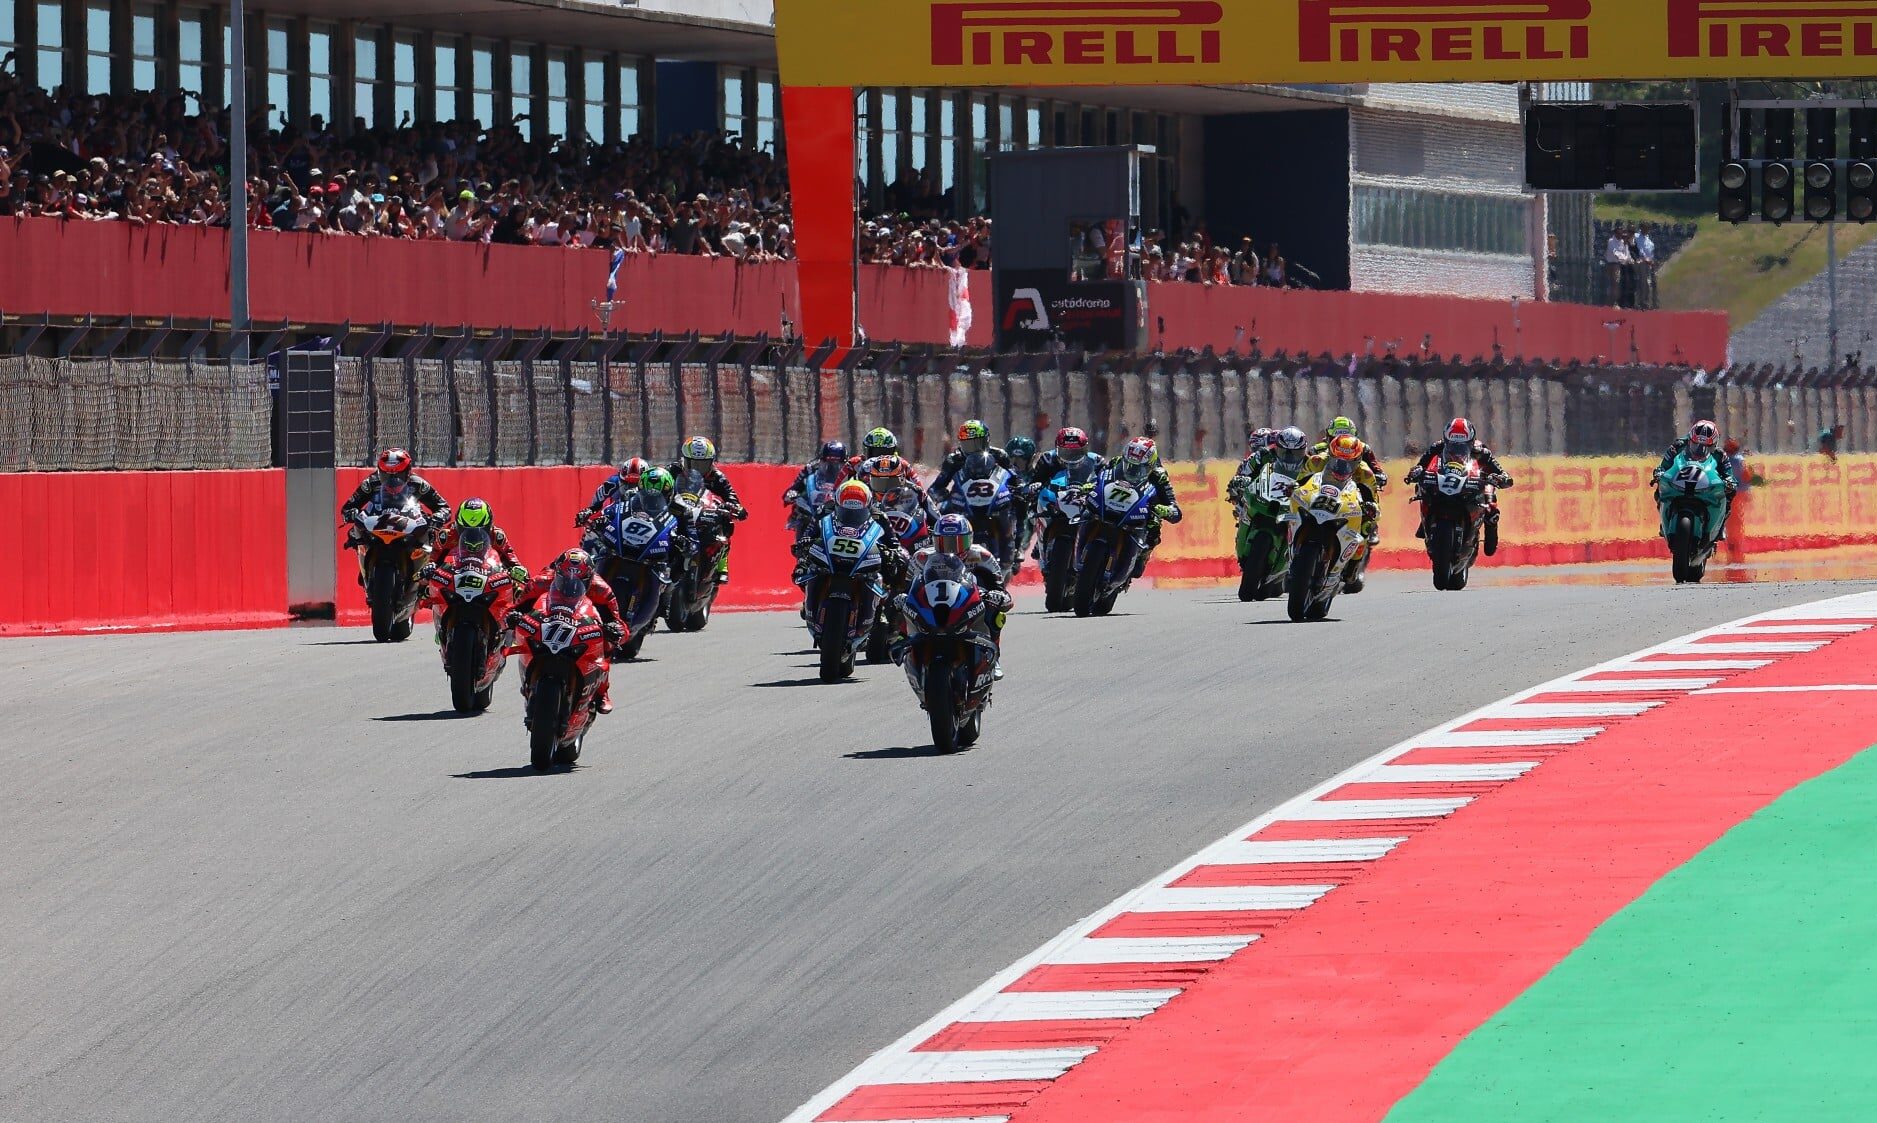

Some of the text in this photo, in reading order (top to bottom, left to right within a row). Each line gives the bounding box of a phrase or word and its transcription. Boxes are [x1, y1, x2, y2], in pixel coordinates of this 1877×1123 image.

[931, 1, 1223, 65] PIRELLI
[1299, 0, 1591, 62] PIRELLI
[1676, 466, 1702, 481] 21
[967, 482, 994, 498] 53
[1442, 476, 1461, 489] 9
[1109, 487, 1131, 502] 77
[624, 522, 652, 536] 87
[833, 538, 860, 554] 55
[935, 582, 950, 602] 1
[545, 623, 574, 643] 11
